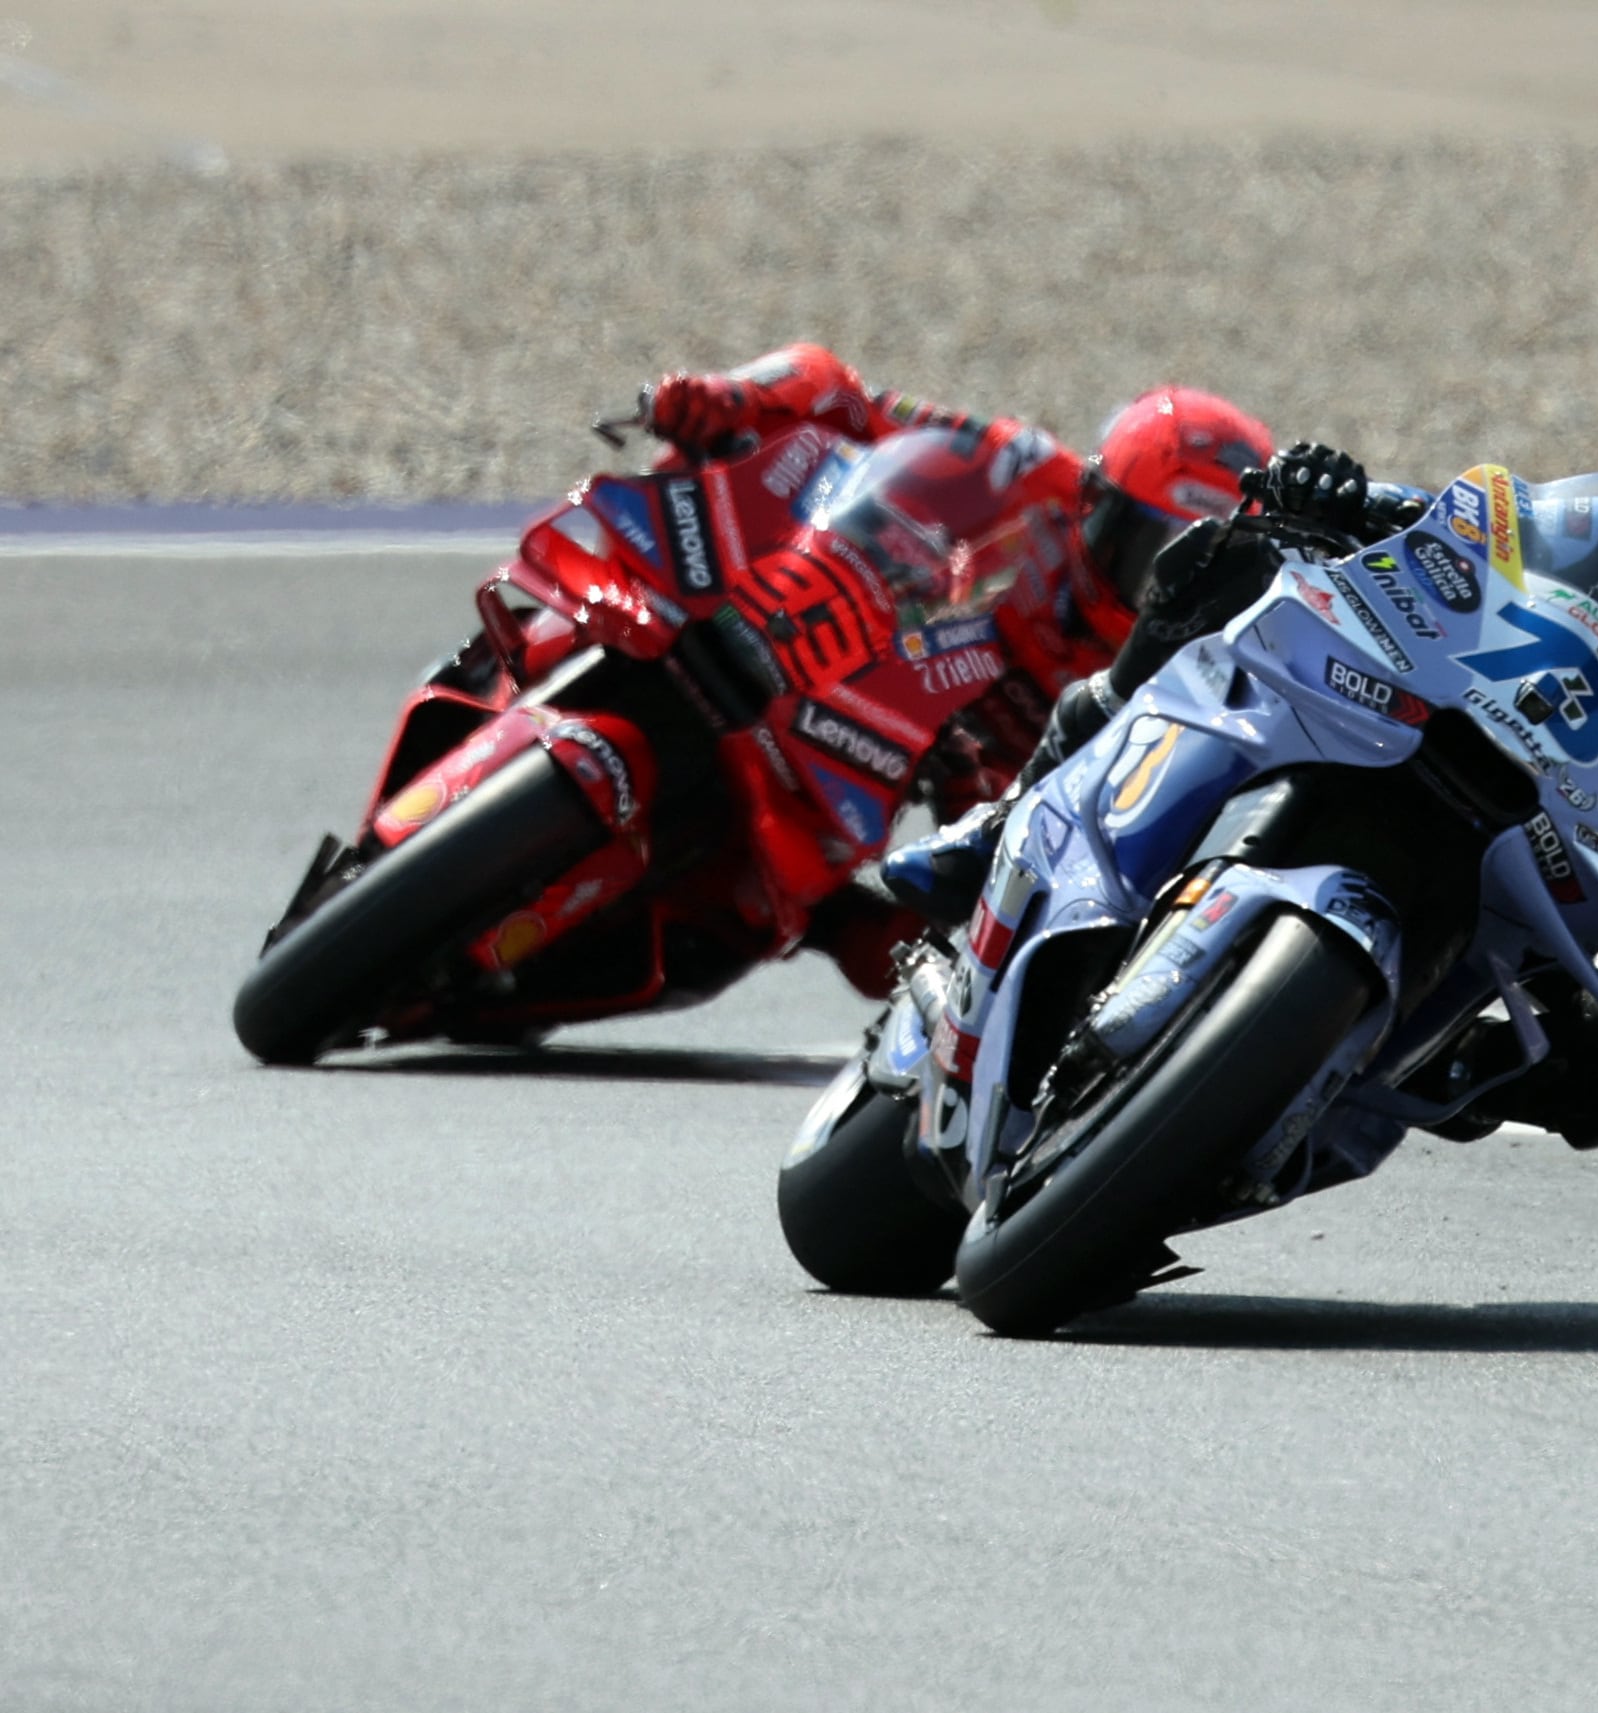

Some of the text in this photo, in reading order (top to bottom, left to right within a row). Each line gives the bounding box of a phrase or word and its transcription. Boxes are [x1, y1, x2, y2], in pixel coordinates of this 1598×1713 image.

[668, 480, 712, 589] Lenovo
[1491, 473, 1514, 562] Antangin
[1414, 546, 1457, 602] Galicia
[1426, 541, 1473, 600] Estrella
[1330, 662, 1392, 705] BOLD
[800, 703, 908, 781] Lenovo
[1531, 812, 1572, 879] BOLD
